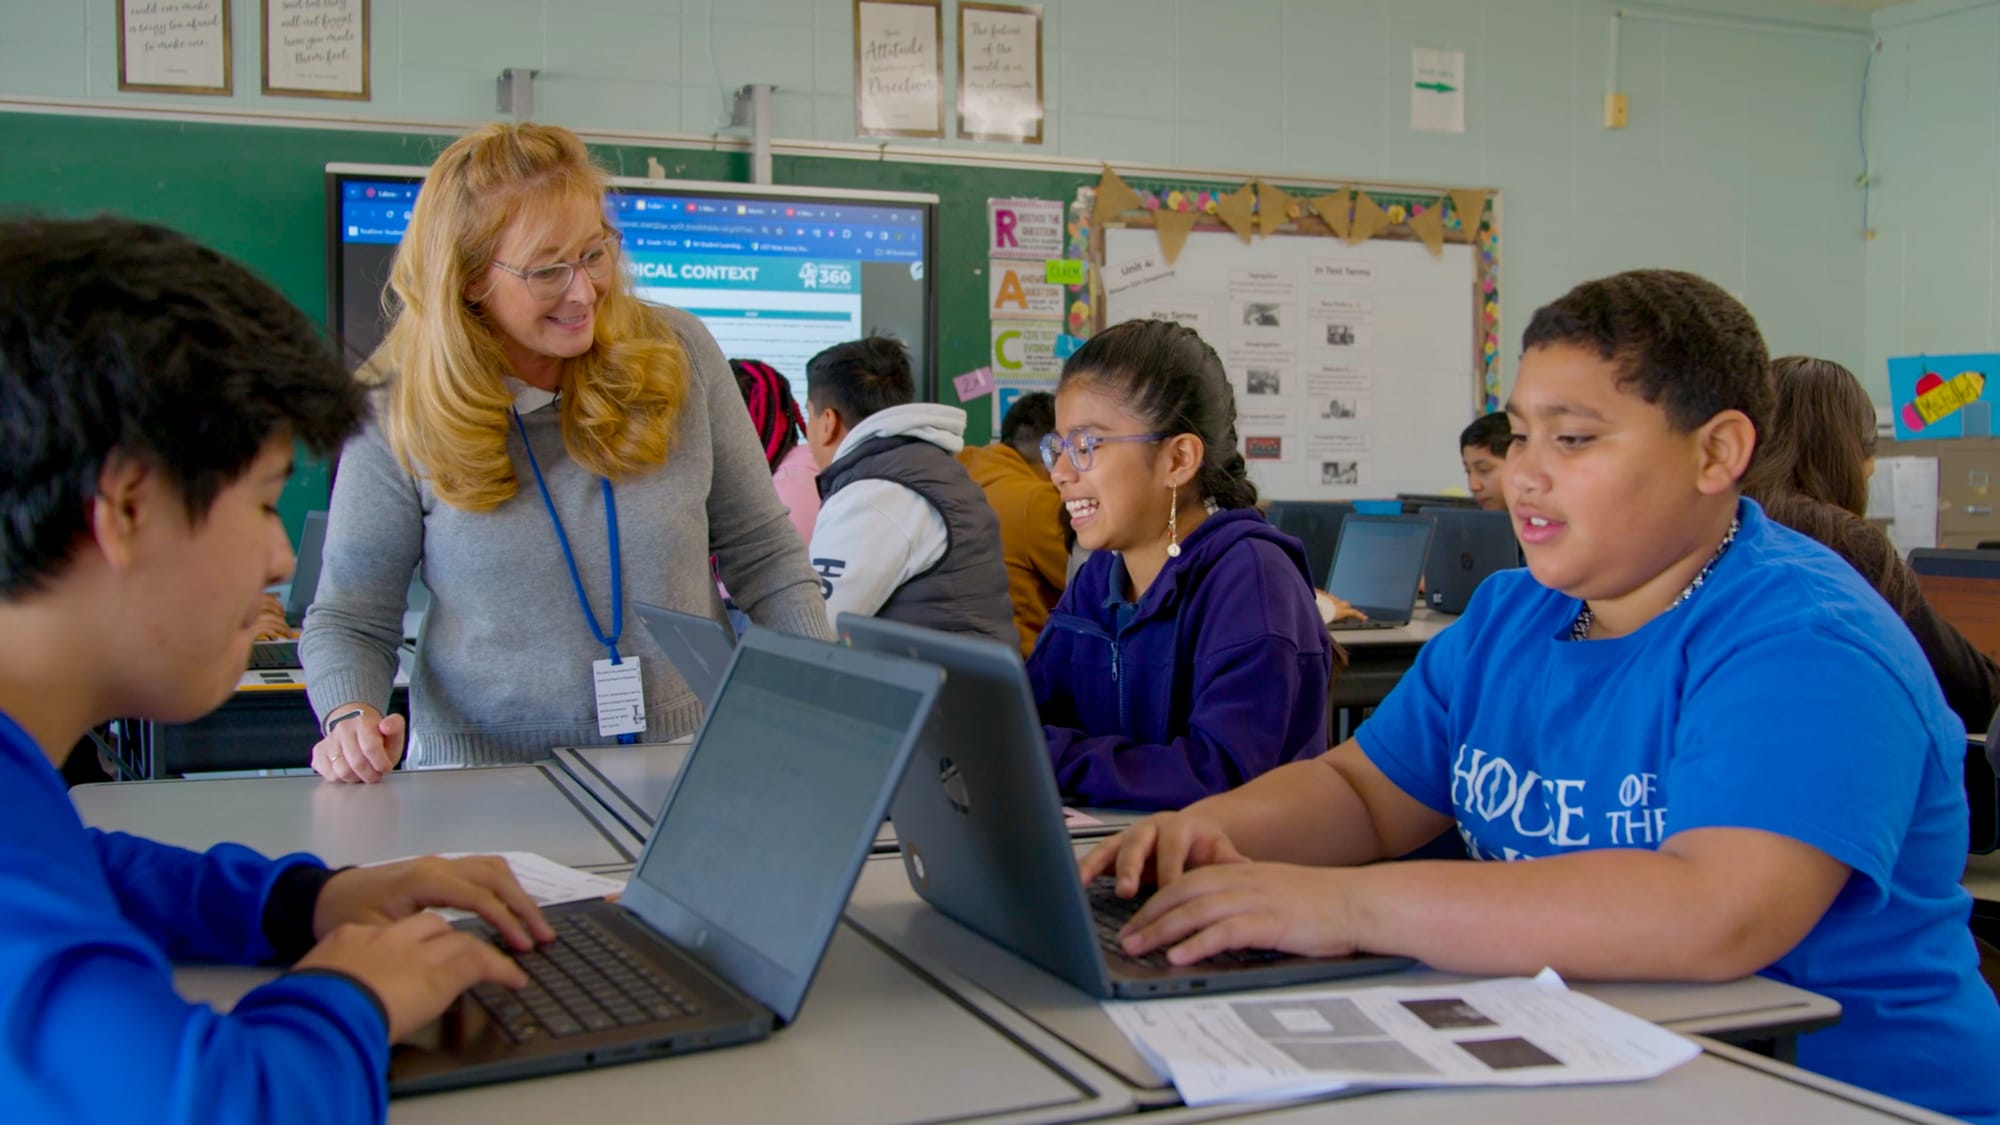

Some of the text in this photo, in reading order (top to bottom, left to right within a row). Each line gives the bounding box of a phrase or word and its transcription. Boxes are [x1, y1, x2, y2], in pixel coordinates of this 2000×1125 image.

[866, 36, 926, 60] Attitude
[995, 209, 1019, 248] R
[681, 263, 759, 281] CONTEXT
[819, 269, 851, 285] 360
[1121, 263, 1143, 276] Unit
[1346, 267, 1371, 277] Terms
[994, 270, 1029, 309] A
[1171, 311, 1199, 321] Terms
[994, 330, 1023, 370] C
[1618, 772, 1658, 808] OF
